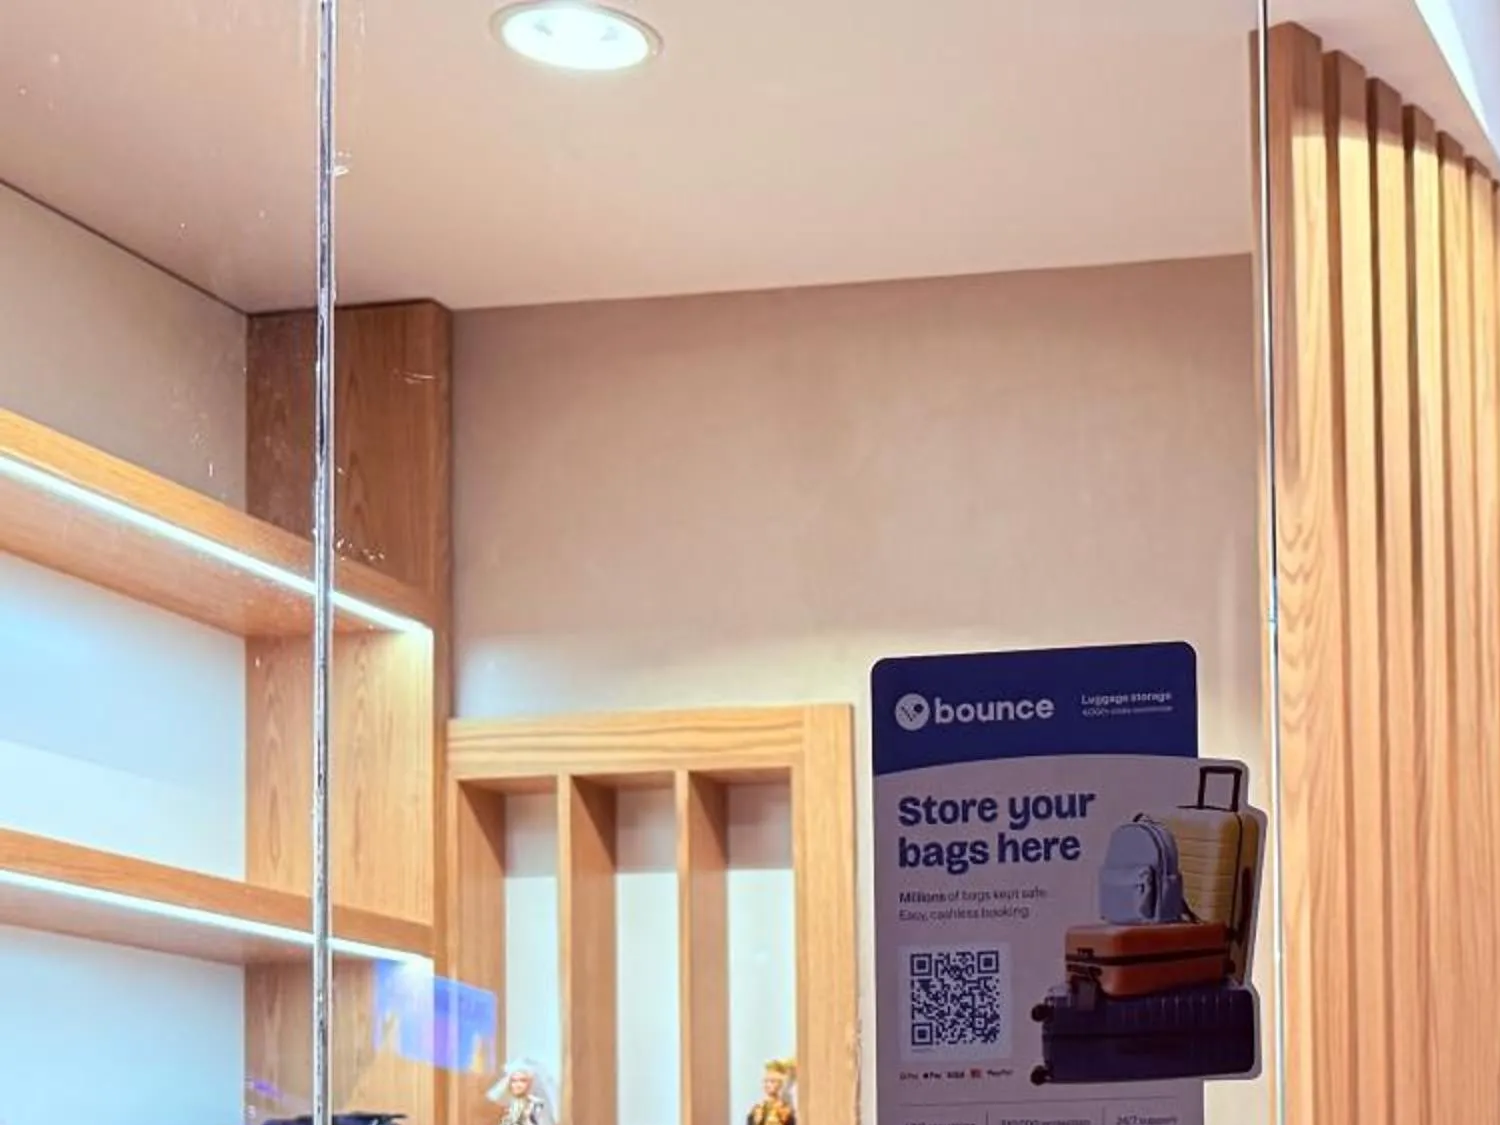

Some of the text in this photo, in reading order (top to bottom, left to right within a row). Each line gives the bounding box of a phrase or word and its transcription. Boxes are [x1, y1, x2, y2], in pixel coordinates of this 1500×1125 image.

[935, 696, 1055, 725] bounce
[898, 793, 1097, 830] Store your
[898, 832, 1081, 875] bags here
[899, 890, 947, 903] Millions
[947, 889, 959, 901] of
